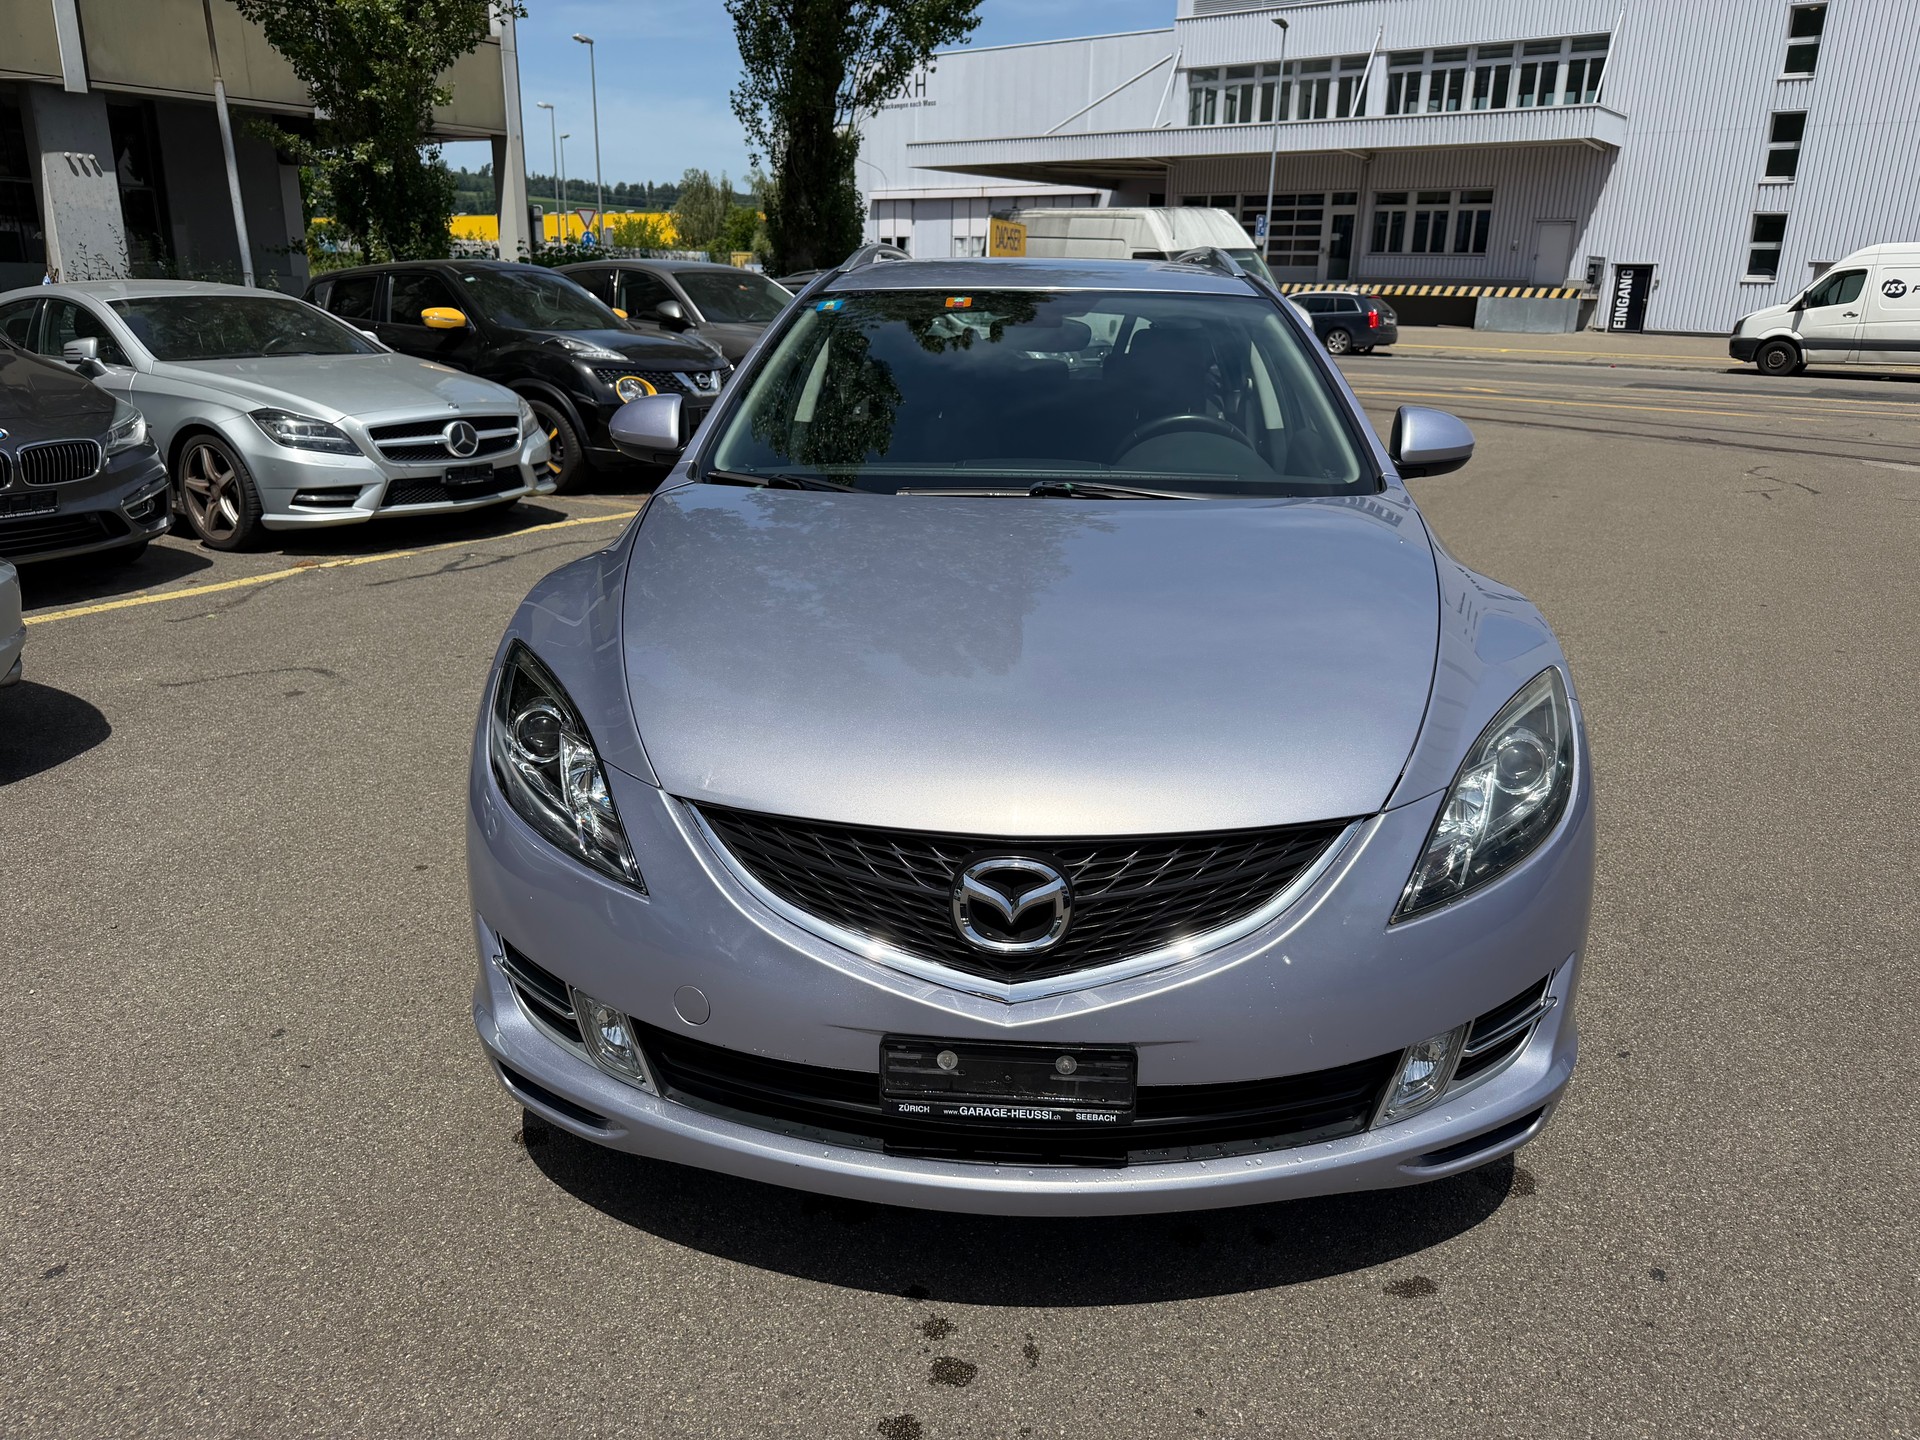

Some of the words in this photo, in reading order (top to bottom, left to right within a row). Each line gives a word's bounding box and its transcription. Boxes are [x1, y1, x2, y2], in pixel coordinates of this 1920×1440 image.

[995, 225, 1022, 252] DACHSER
[1612, 269, 1635, 329] EINGANG
[898, 1103, 930, 1113] ZÜRICH
[943, 1106, 1062, 1121] www.GARAGE-HEUSSI.ch
[1075, 1112, 1117, 1122] SEEBACH
